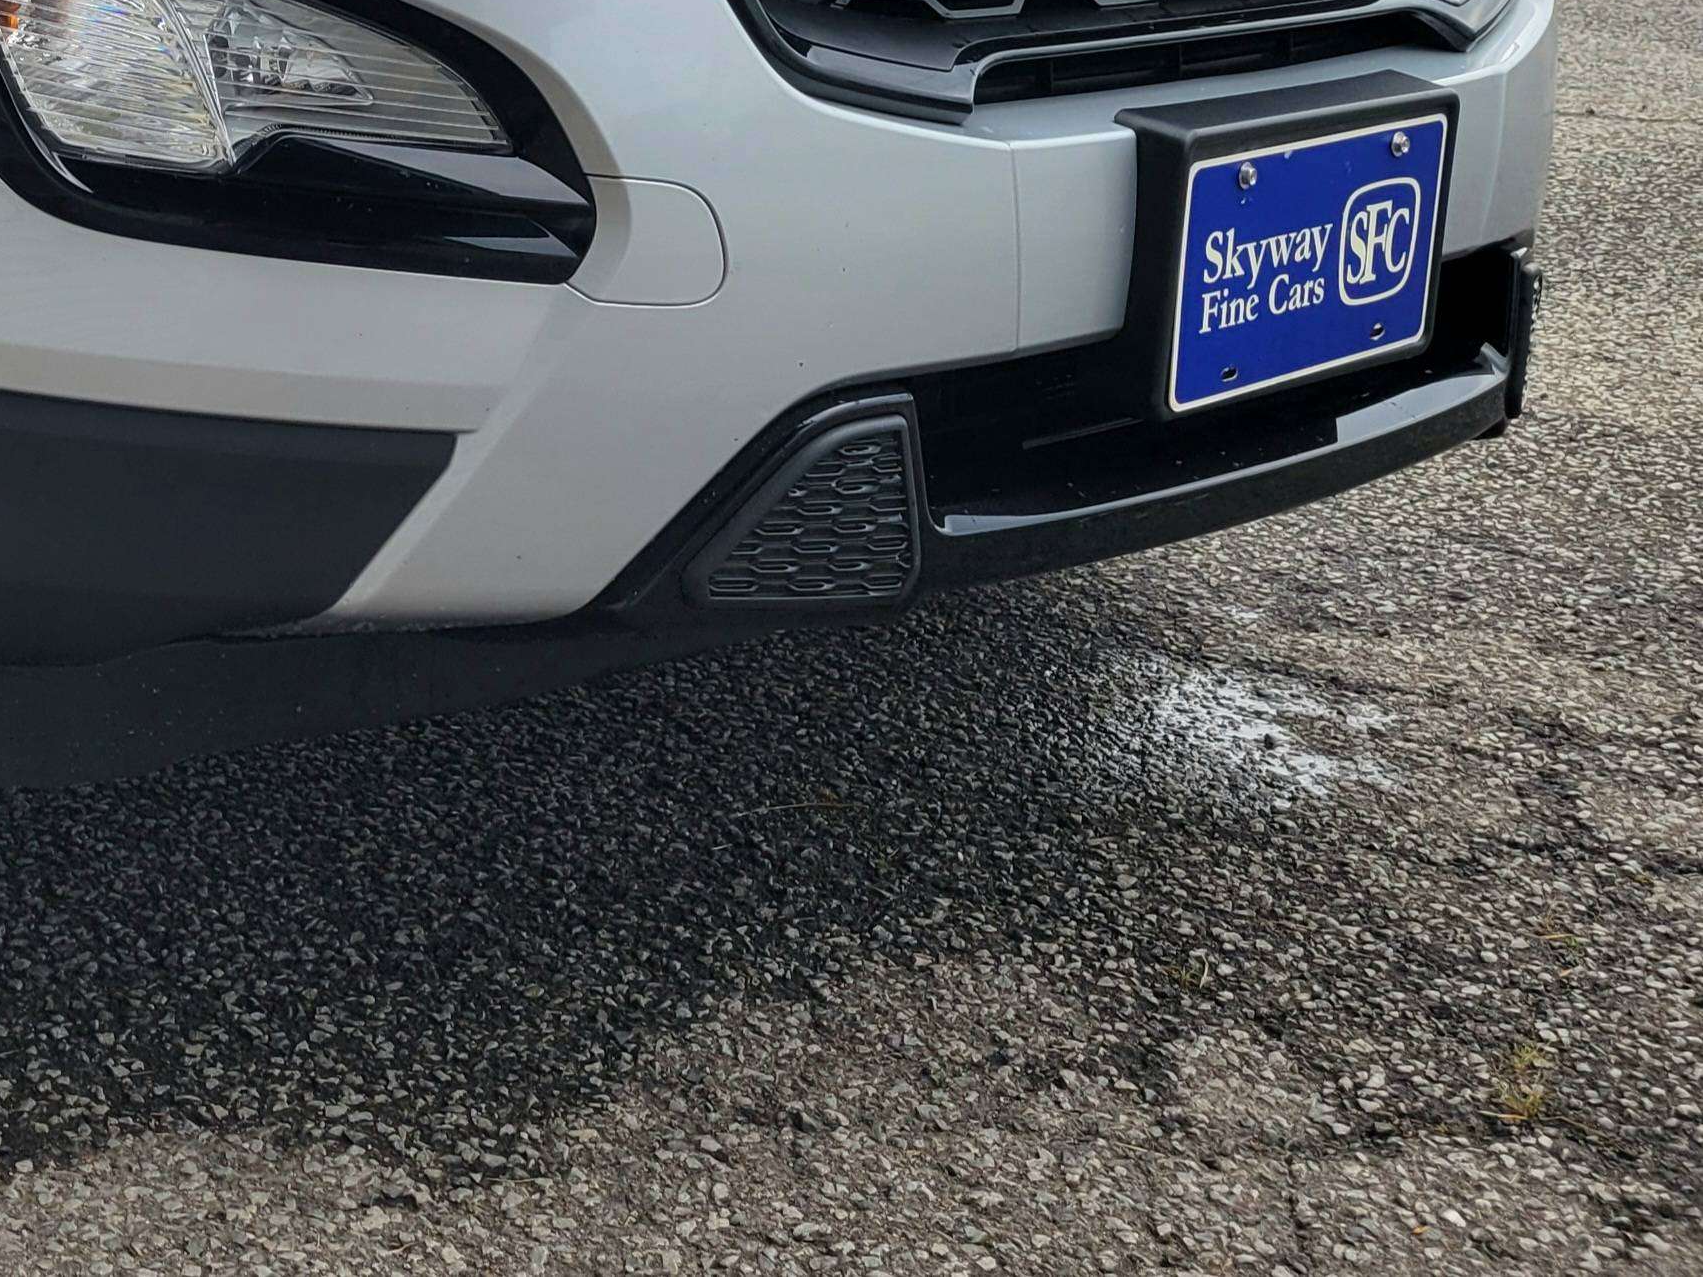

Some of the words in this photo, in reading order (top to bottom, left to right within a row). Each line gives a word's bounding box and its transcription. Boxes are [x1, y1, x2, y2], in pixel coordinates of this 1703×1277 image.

[1202, 222, 1334, 290] Skyway
[1346, 199, 1411, 285] SFC
[1198, 288, 1260, 335] Fine
[1267, 273, 1326, 316] Cars
